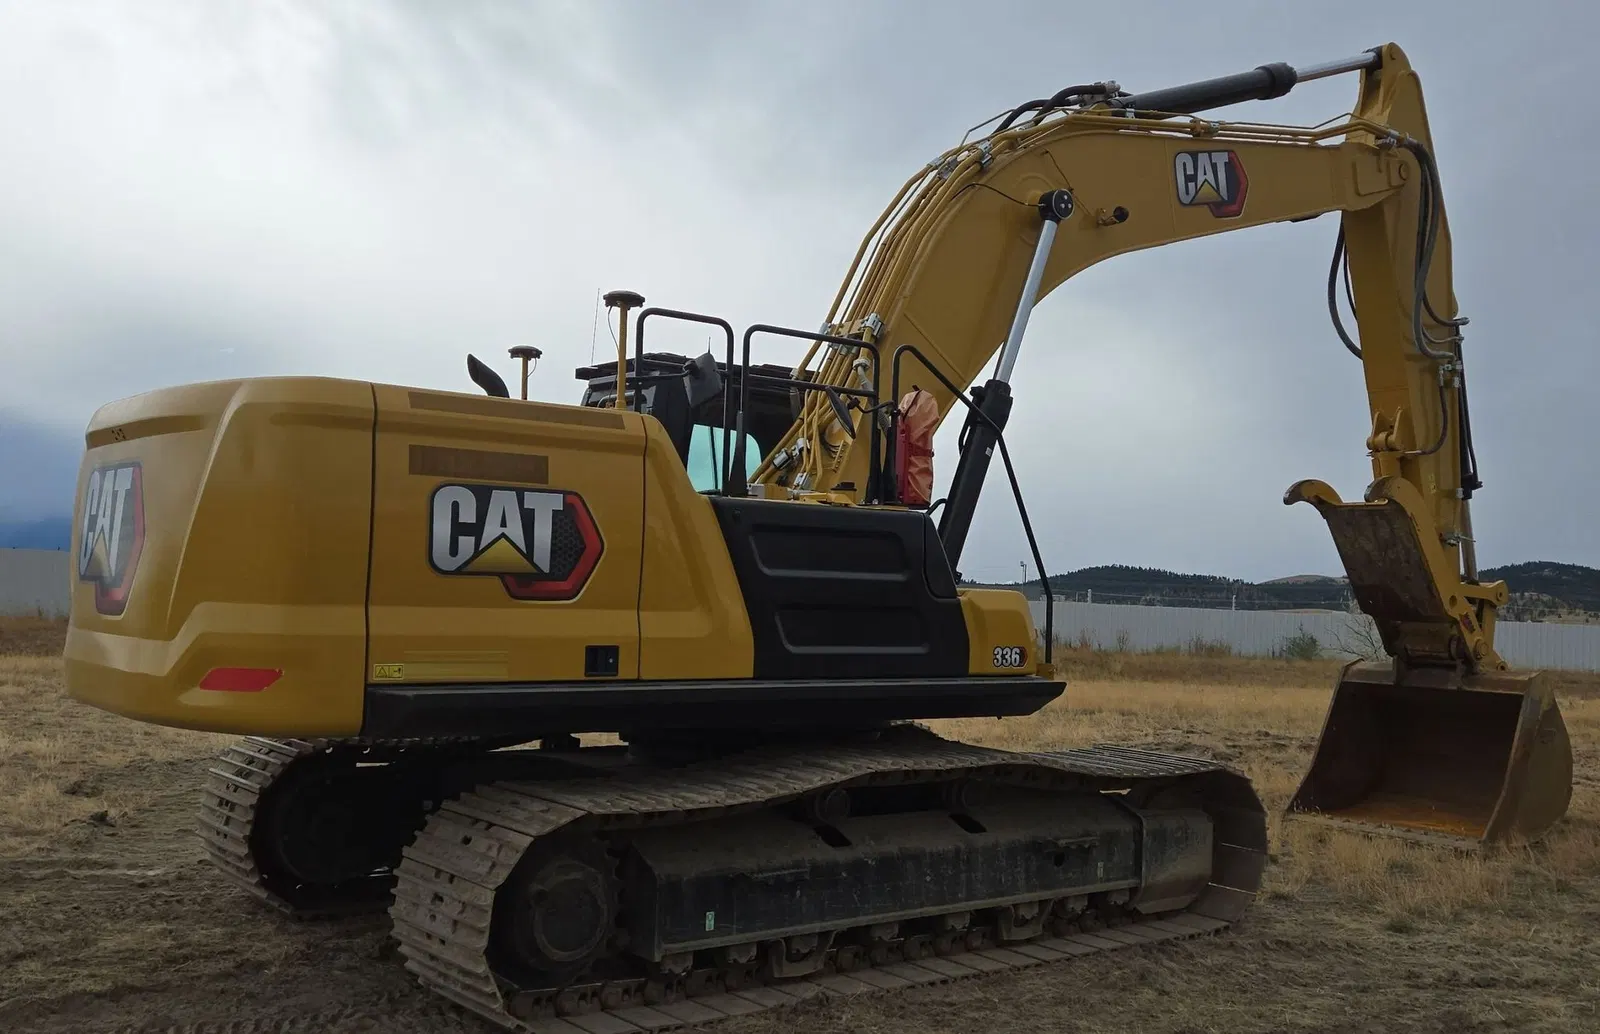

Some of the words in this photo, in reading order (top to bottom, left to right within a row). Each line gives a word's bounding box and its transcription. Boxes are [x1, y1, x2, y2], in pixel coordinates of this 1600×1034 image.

[1175, 152, 1229, 204] CAT
[80, 467, 134, 576] CAT
[432, 485, 564, 574] CAT
[993, 647, 1020, 667] 336
